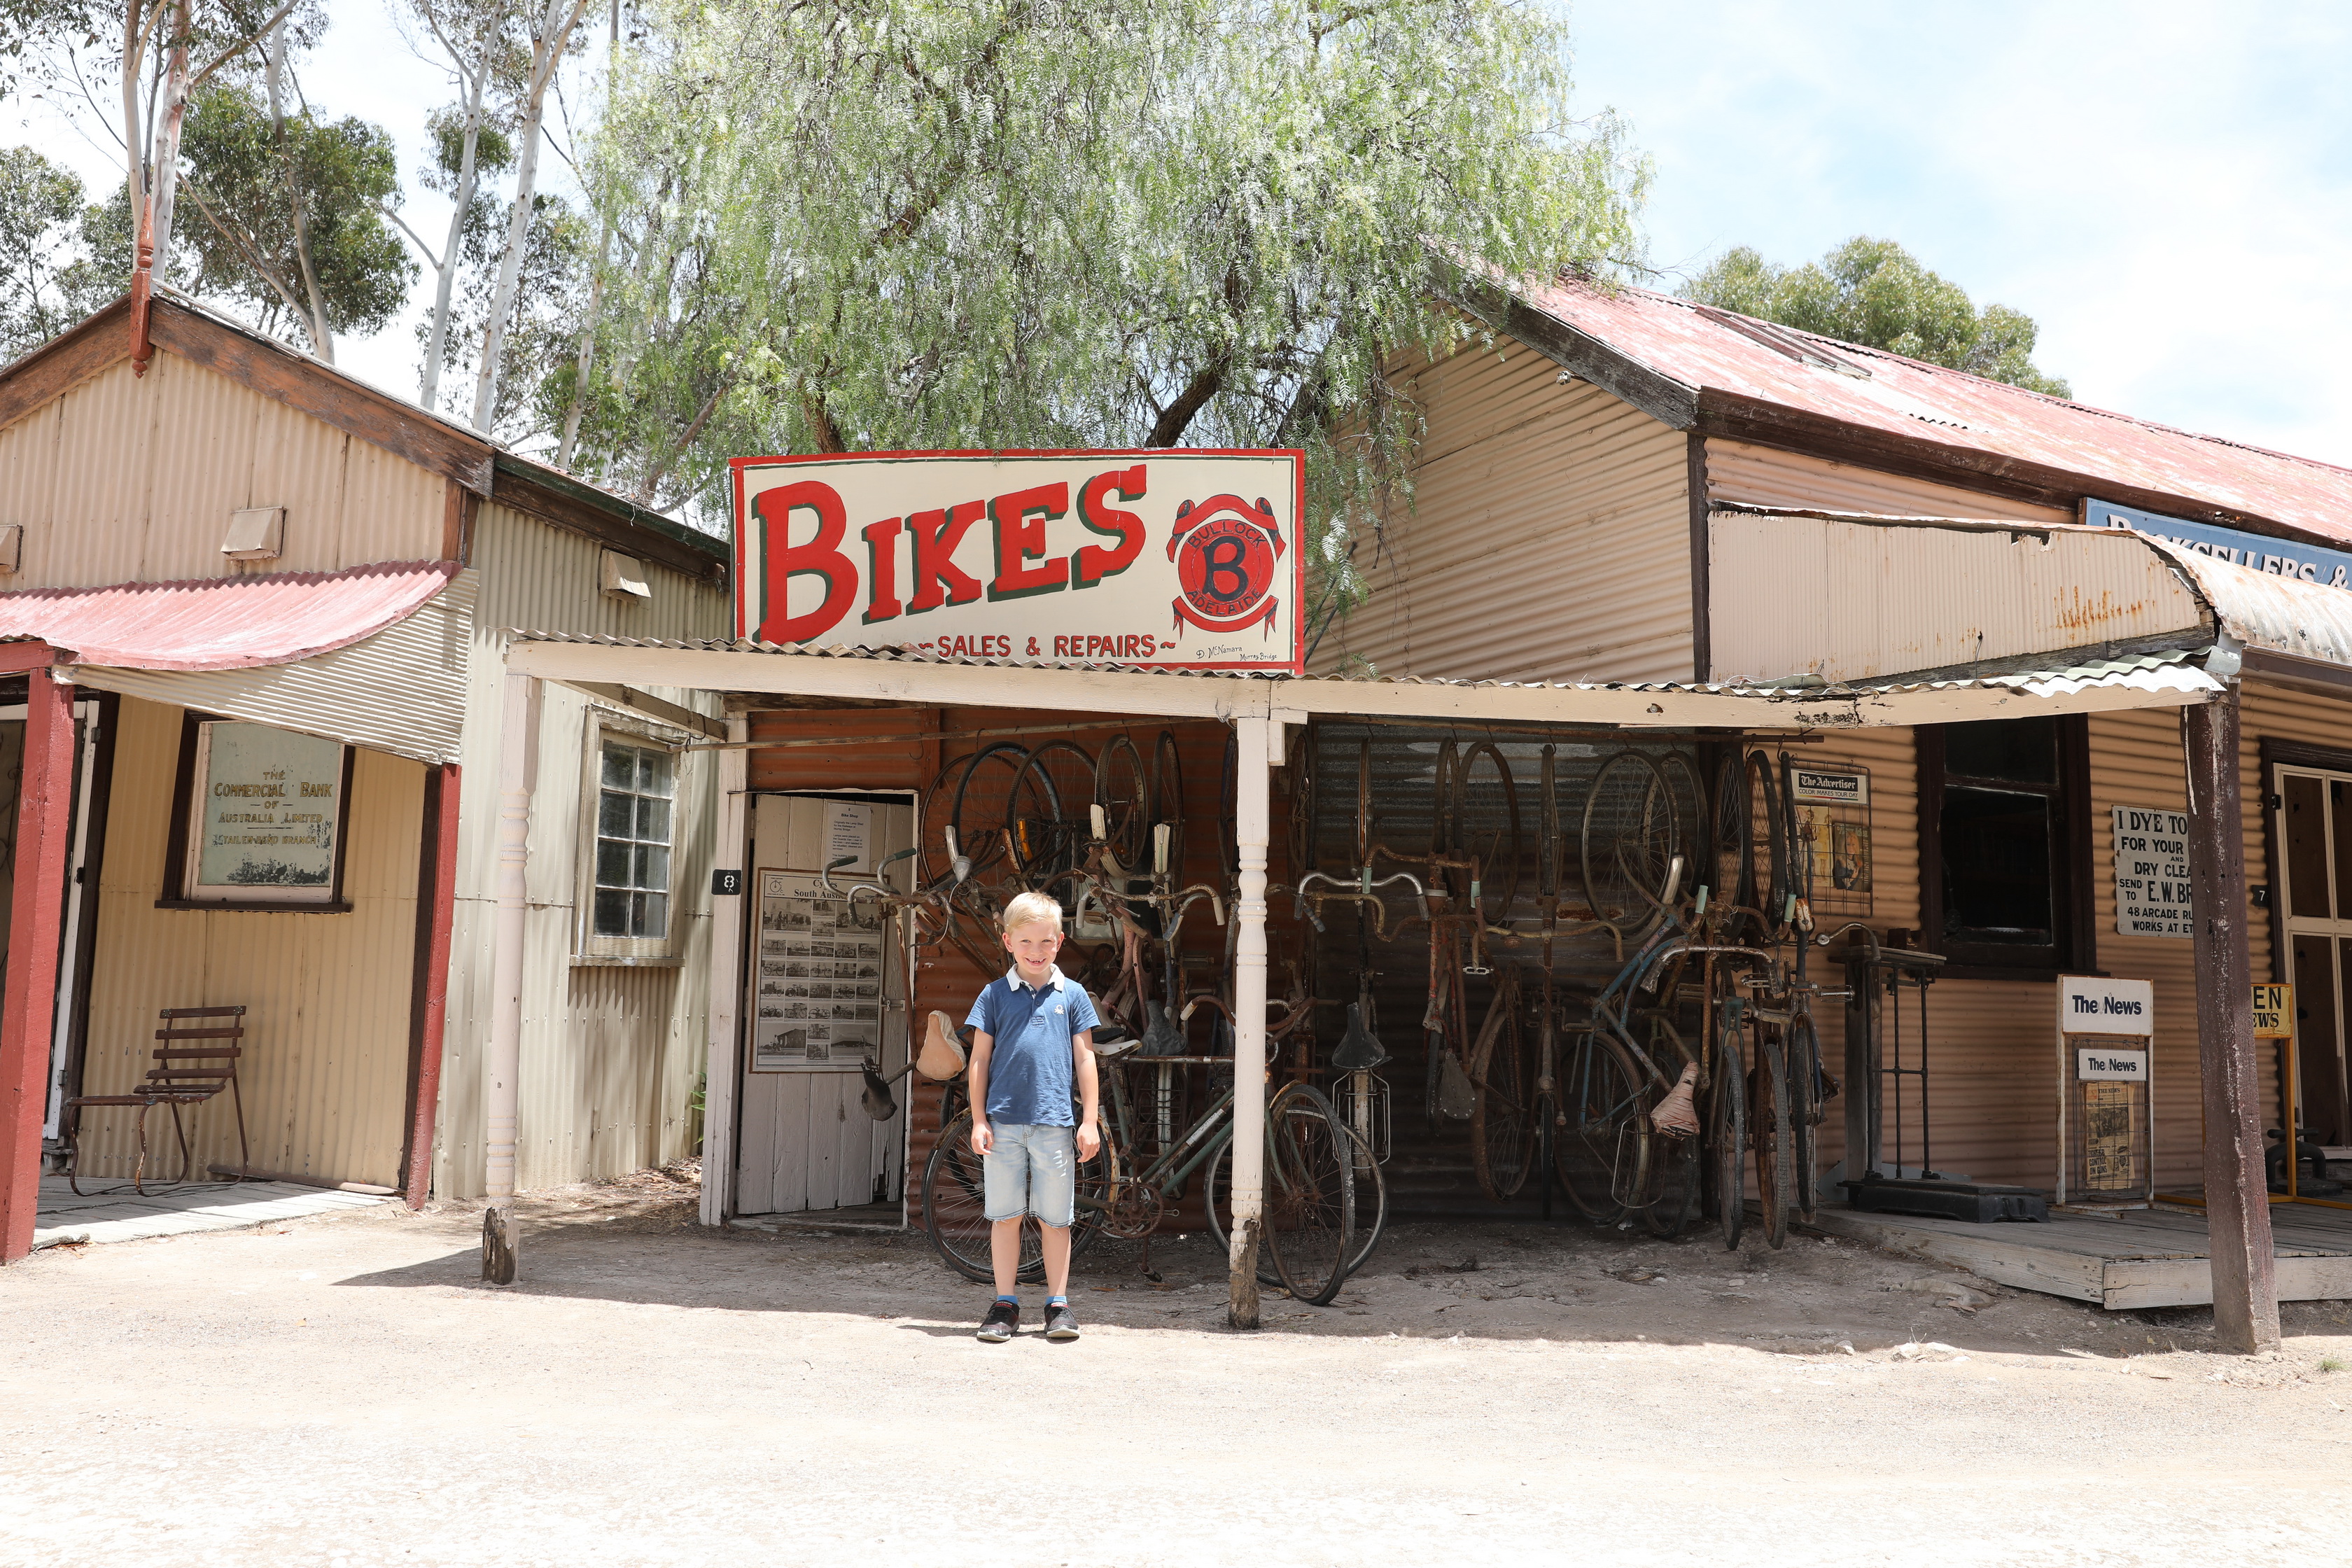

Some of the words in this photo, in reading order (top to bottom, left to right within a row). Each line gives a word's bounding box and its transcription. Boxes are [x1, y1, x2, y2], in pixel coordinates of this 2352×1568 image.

[1188, 522, 1266, 549] BULLOCK
[751, 463, 1147, 645] BIKES
[1202, 536, 1248, 602] B
[1187, 589, 1263, 615] ADELAIDE
[1026, 636, 1041, 656] &
[1208, 644, 1242, 658] McNamara
[1260, 652, 1277, 661] Bridge
[263, 771, 286, 780] THE
[1801, 775, 1816, 786] The
[1816, 777, 1856, 789] Advertiser
[214, 782, 286, 797] COMMERCIAL
[300, 782, 333, 797] BANK
[264, 800, 279, 809] OF
[218, 812, 274, 823] AUSTRALIA
[284, 812, 323, 823] LIMITED
[2117, 810, 2123, 829] I
[2129, 811, 2163, 833] DYE
[2168, 815, 2188, 835] TO
[282, 835, 316, 845] BRANCH
[2121, 836, 2147, 851] FOR
[2152, 839, 2184, 854] YOUR
[2134, 862, 2158, 876] DRY
[724, 875, 735, 888] 8
[813, 879, 837, 888] Cyes
[2119, 878, 2142, 889] SEND
[794, 889, 817, 897] South
[2126, 891, 2136, 900] TO
[2259, 890, 2265, 901] 7
[2128, 907, 2140, 916] 48
[2142, 908, 2178, 919] ARCADE
[2132, 920, 2163, 932] WORKS
[2167, 923, 2178, 933] AT
[2072, 995, 2098, 1014] The
[2104, 996, 2142, 1015] News
[2088, 1058, 2105, 1071] The
[2109, 1058, 2137, 1072] News
